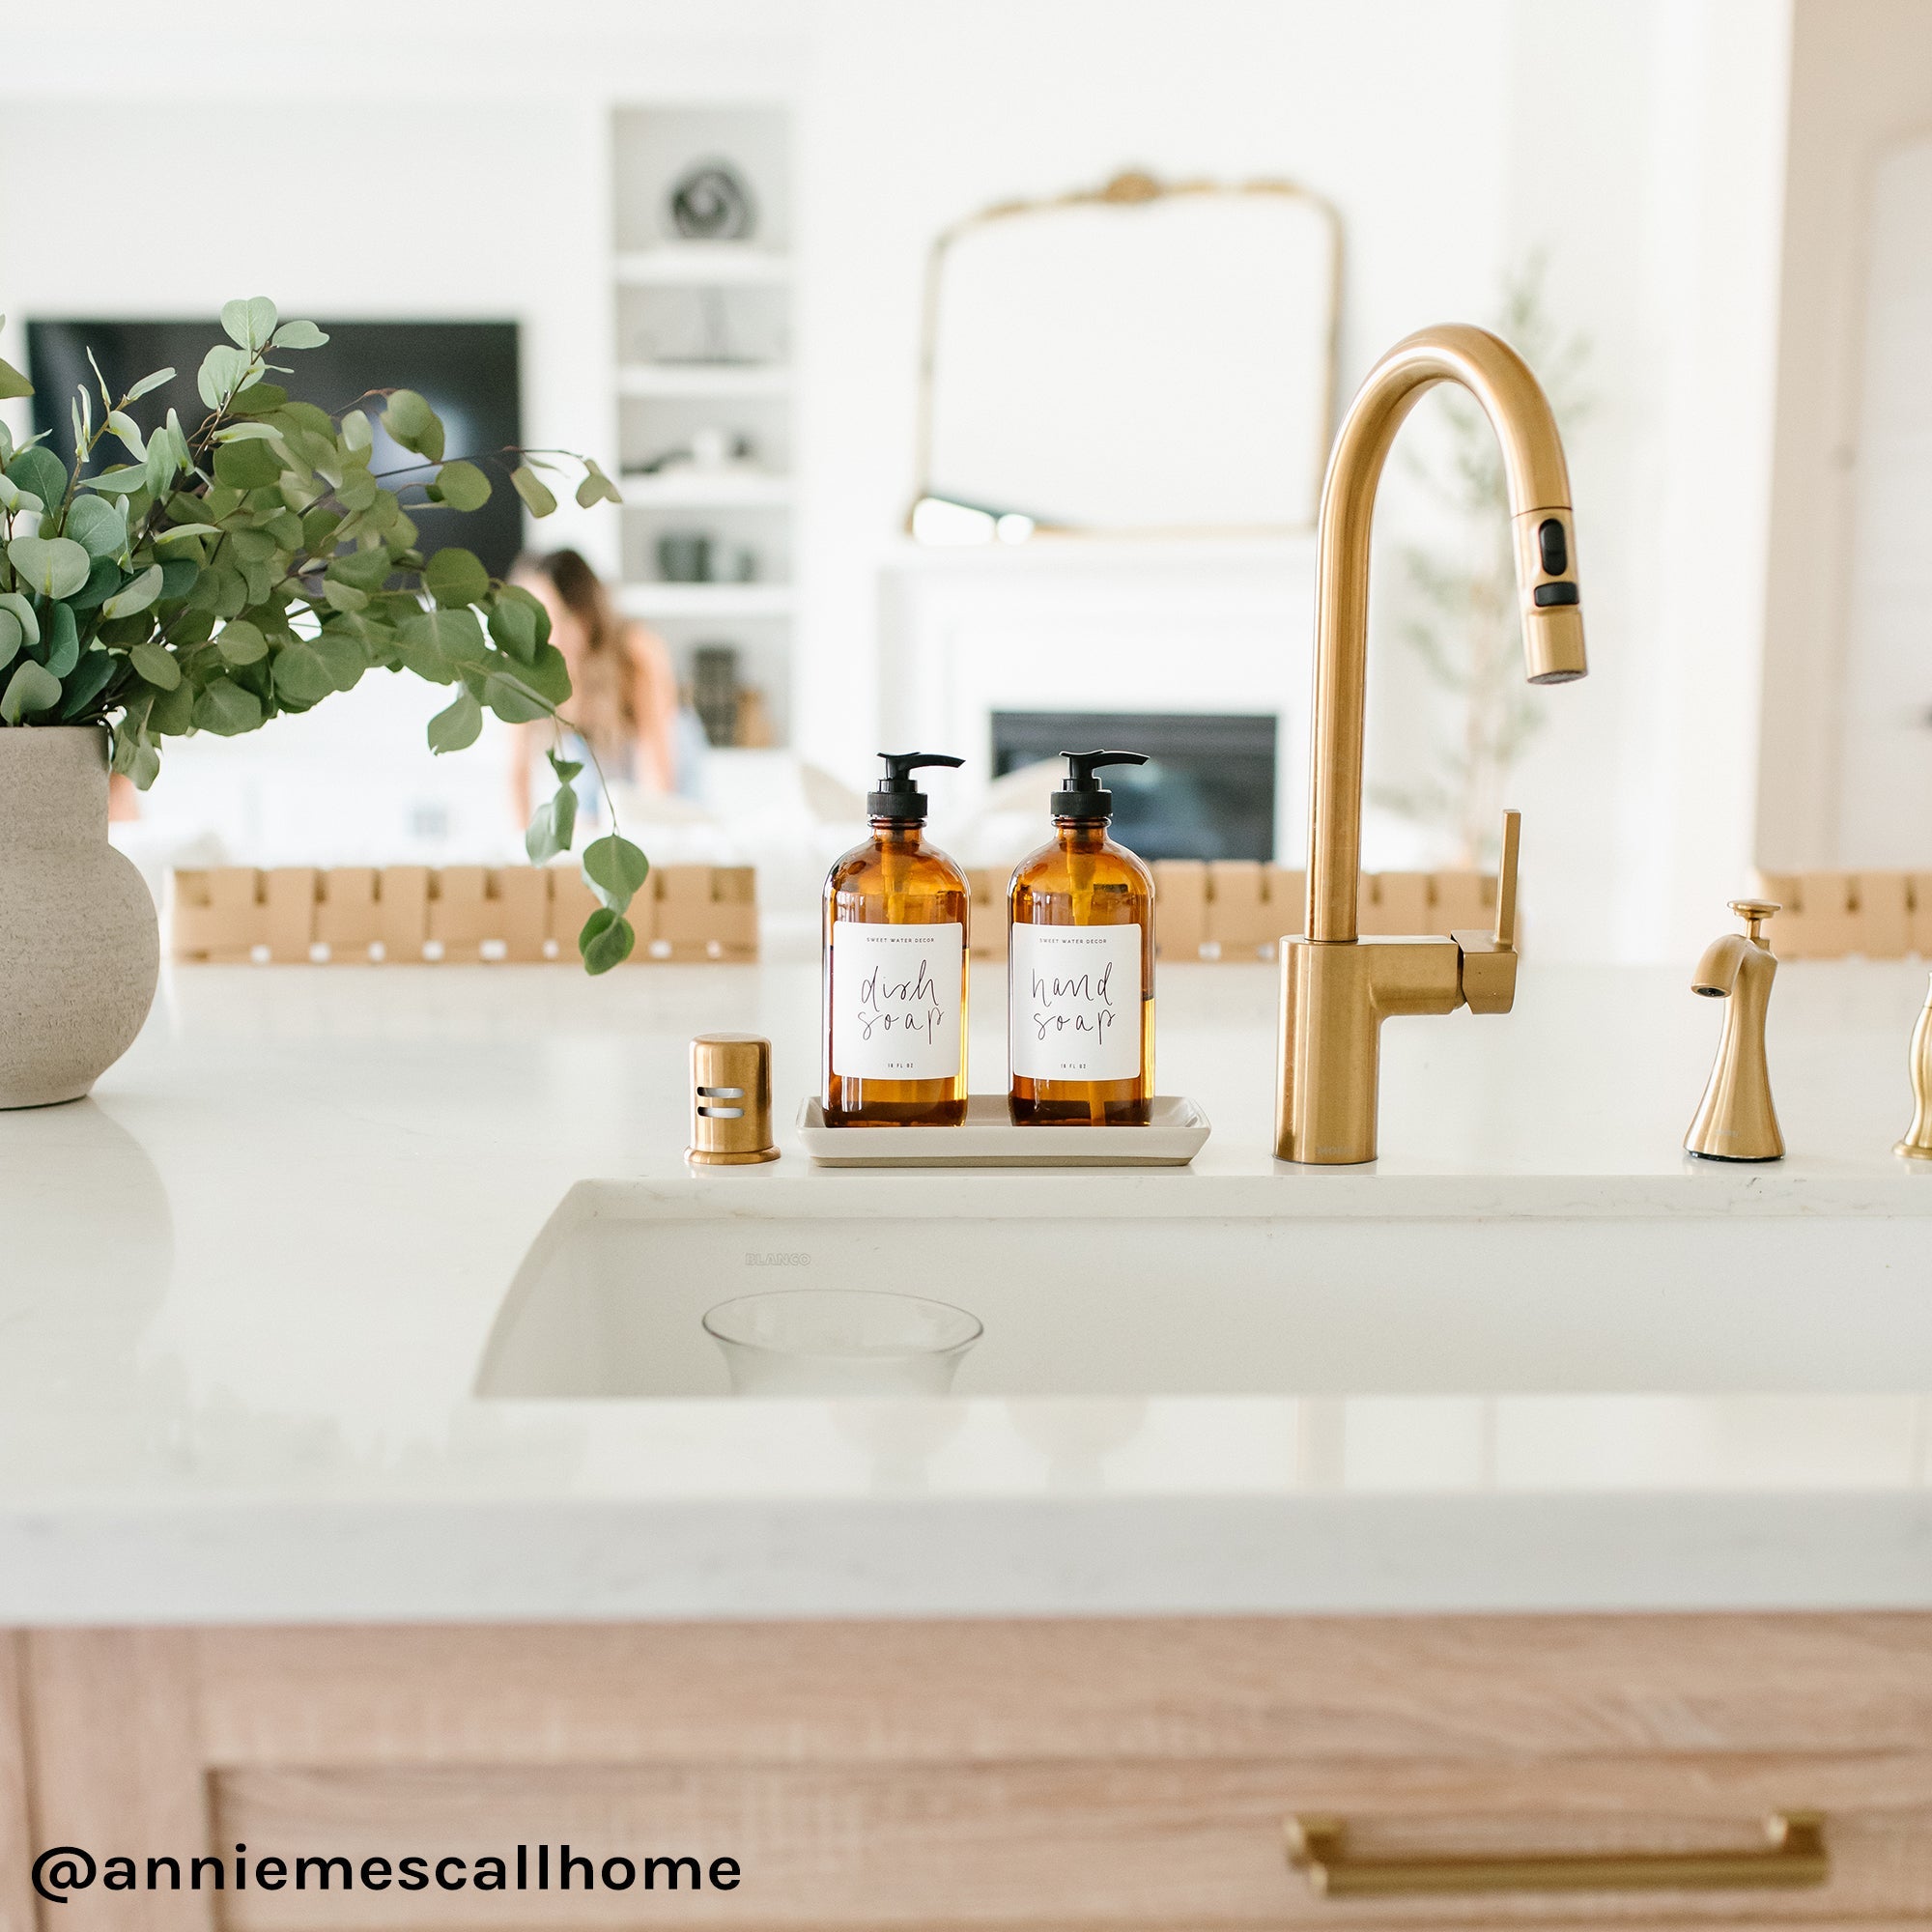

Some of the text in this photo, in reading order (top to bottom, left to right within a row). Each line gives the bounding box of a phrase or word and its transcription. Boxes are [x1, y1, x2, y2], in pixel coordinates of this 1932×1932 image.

[861, 959, 939, 1012] dish
[1032, 961, 1113, 1008] hand
[857, 1007, 945, 1045] soap
[1033, 1009, 1116, 1045] soap
[745, 1252, 812, 1266] BLANCO
